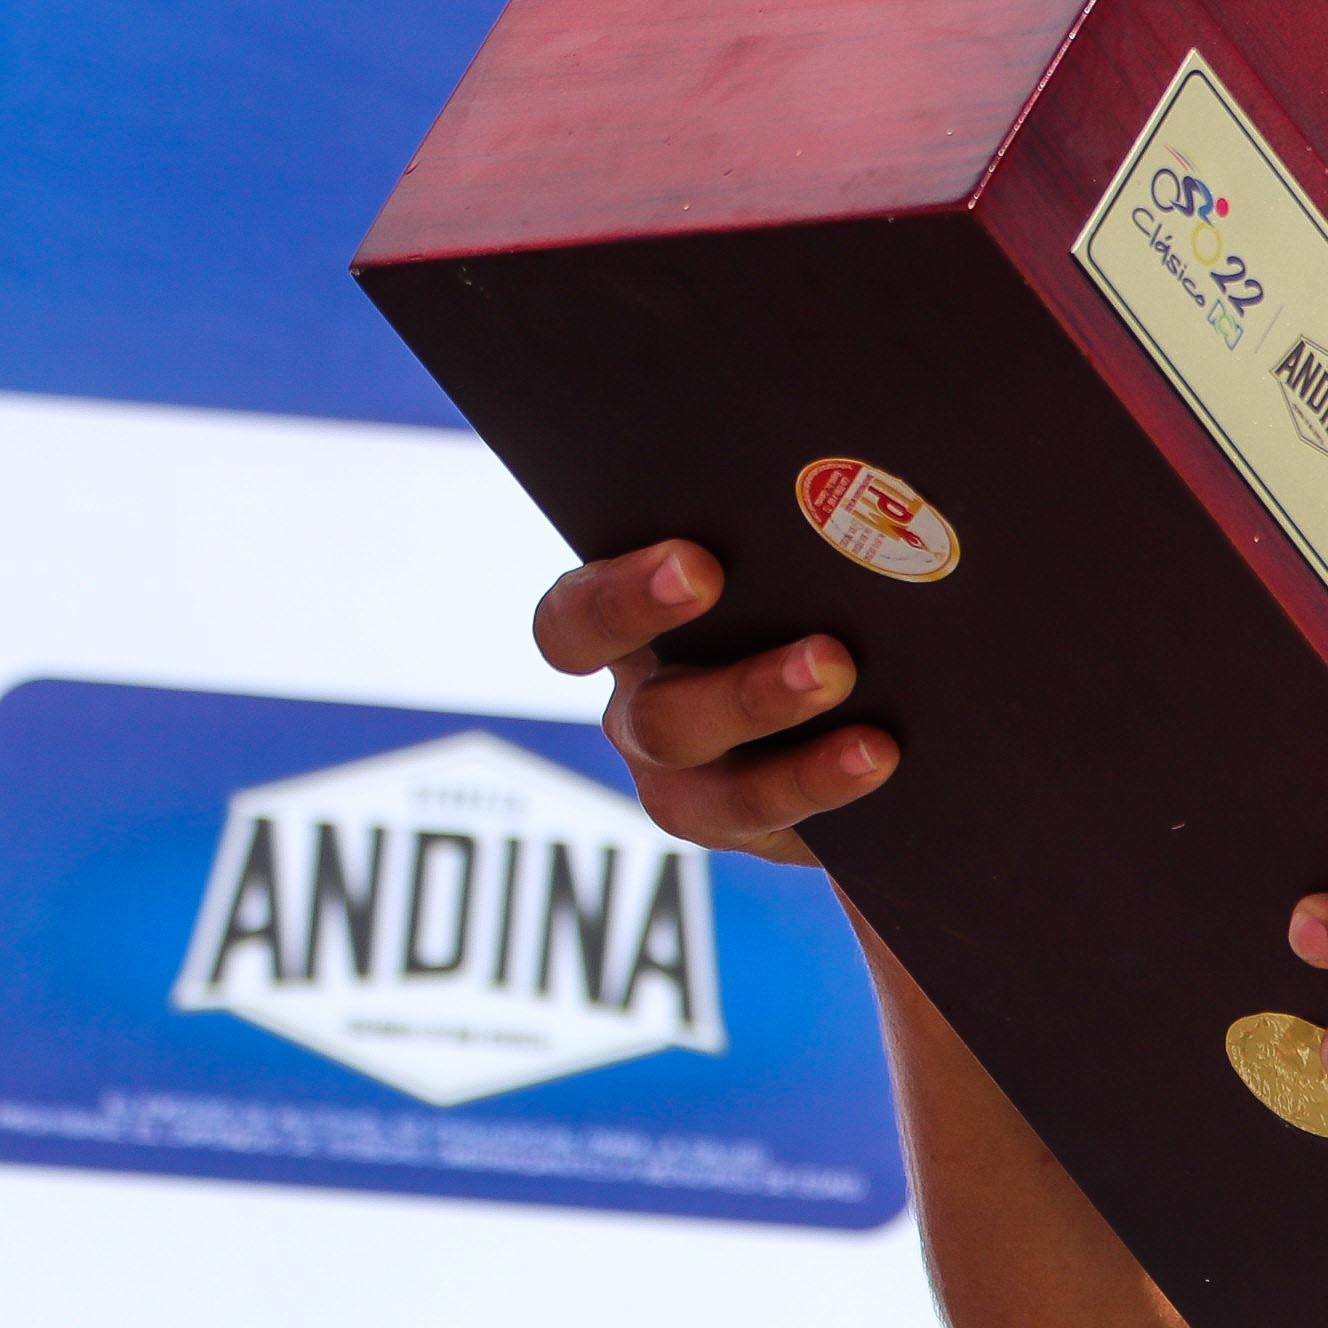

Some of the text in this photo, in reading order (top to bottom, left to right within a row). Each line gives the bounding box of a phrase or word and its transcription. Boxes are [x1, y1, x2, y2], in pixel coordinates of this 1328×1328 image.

[1132, 207, 1205, 307] Clásico
[1211, 256, 1264, 317] 22
[208, 815, 698, 1024] ANDINA
